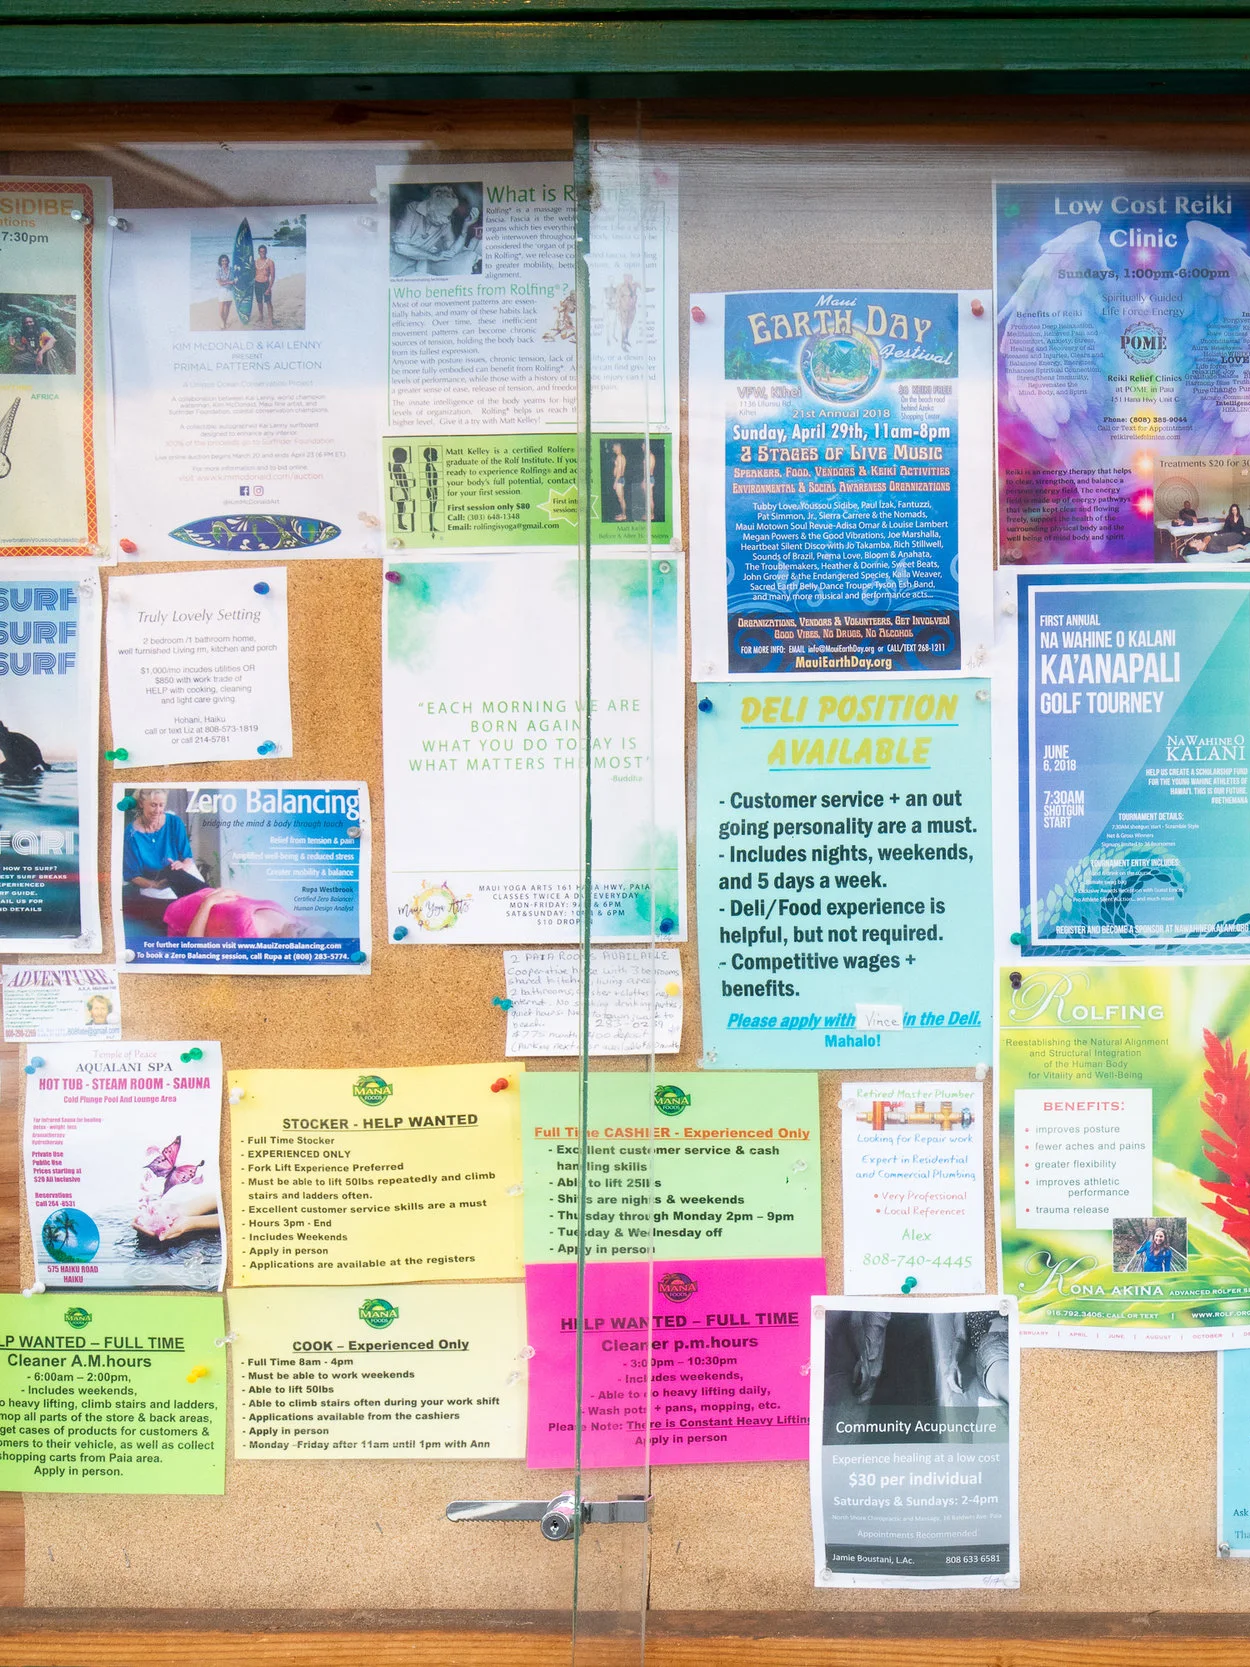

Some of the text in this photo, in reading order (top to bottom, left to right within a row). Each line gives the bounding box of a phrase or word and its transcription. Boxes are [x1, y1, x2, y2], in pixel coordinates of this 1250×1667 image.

[1054, 194, 1232, 215] Low Cost Reiki
[1, 231, 48, 245] 7:30pm
[1109, 227, 1177, 248] Clinic
[816, 294, 857, 307] Maui
[748, 304, 931, 346] EARTH DAY
[732, 422, 950, 443] Sunday, April 29th, 11am-8pm
[1159, 460, 1206, 468] Treatments
[1208, 459, 1224, 467] $20
[1226, 458, 1239, 467] for
[447, 502, 530, 511] First session only $80
[447, 512, 520, 521] Call: (303) 648-1348
[137, 608, 261, 626] Truly Lovely Setting
[1040, 629, 1175, 649] NA WAHINE O KALANI
[795, 655, 892, 670] MauiEarthDay.org
[740, 693, 958, 724] DELI POSITION
[1040, 692, 1164, 714] GOLF TOURNEY
[180, 736, 193, 744] call
[194, 735, 229, 744] 214-5781
[767, 736, 932, 768] AVAILABLE
[184, 787, 360, 821] Zero Balancing
[301, 886, 318, 894] Rupa
[824, 1033, 880, 1048] Mahalo!
[76, 1062, 173, 1074] AQUALANI SPA
[1043, 1101, 1124, 1111] BENEFITS:
[1034, 1159, 1116, 1171] greater flexibility
[862, 1252, 972, 1268] 808-740-4445
[7, 1354, 151, 1368] Cleaner A.M.hours
[835, 1420, 996, 1434] Community Acupuncture
[945, 1554, 1000, 1564] 808 633 6581
